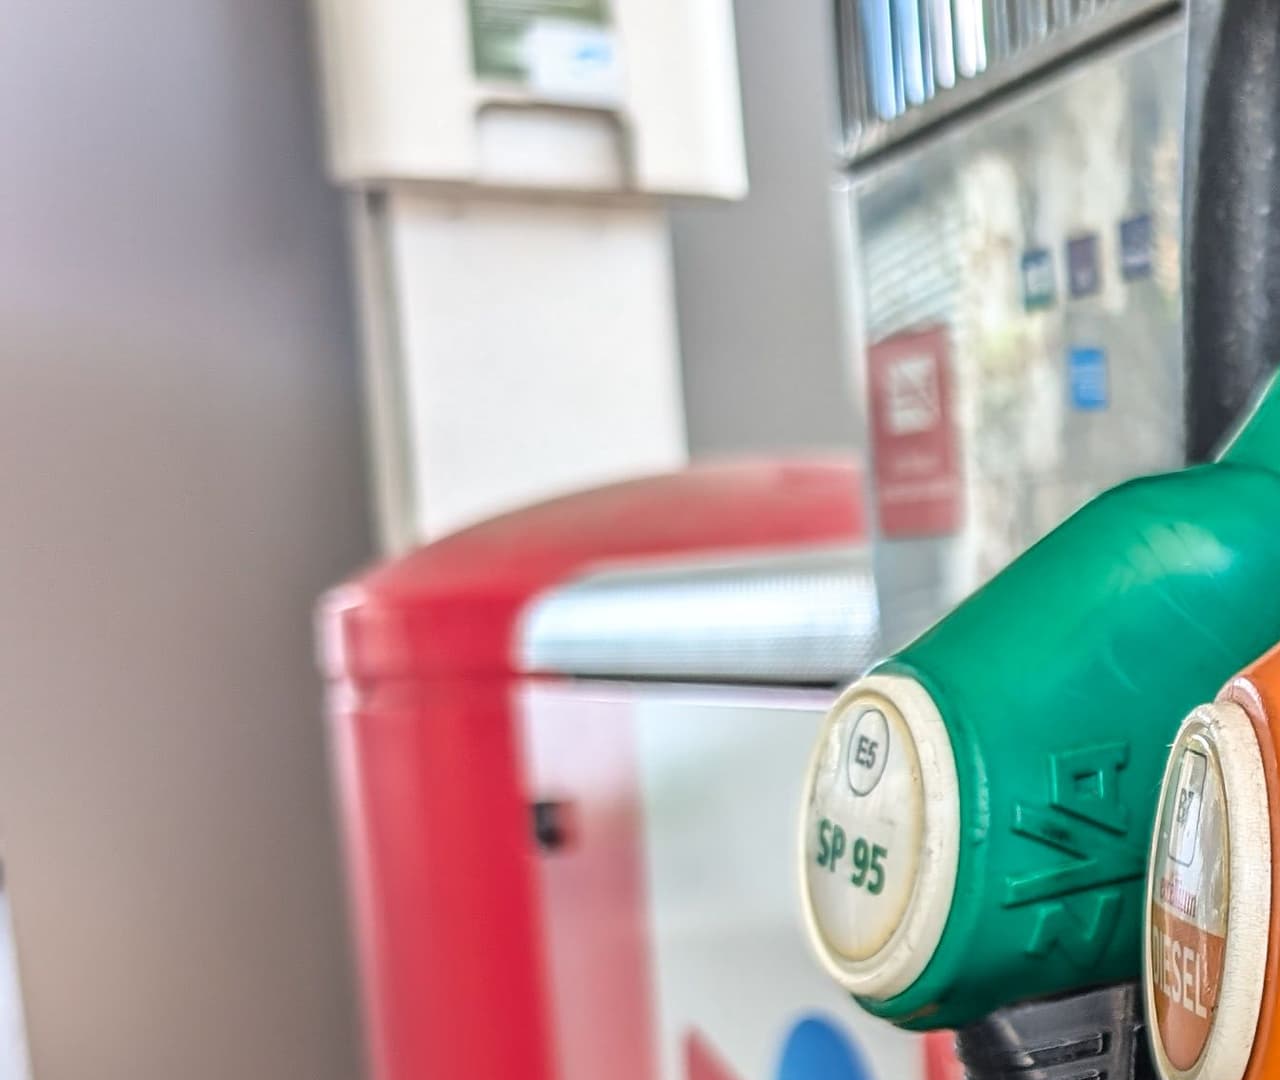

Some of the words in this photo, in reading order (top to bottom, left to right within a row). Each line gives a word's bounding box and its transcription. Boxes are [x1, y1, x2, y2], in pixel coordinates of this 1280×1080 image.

[855, 735, 878, 769] E5
[816, 817, 847, 873] SP
[850, 837, 889, 896] 95
[1153, 925, 1208, 1020] DIESEL
